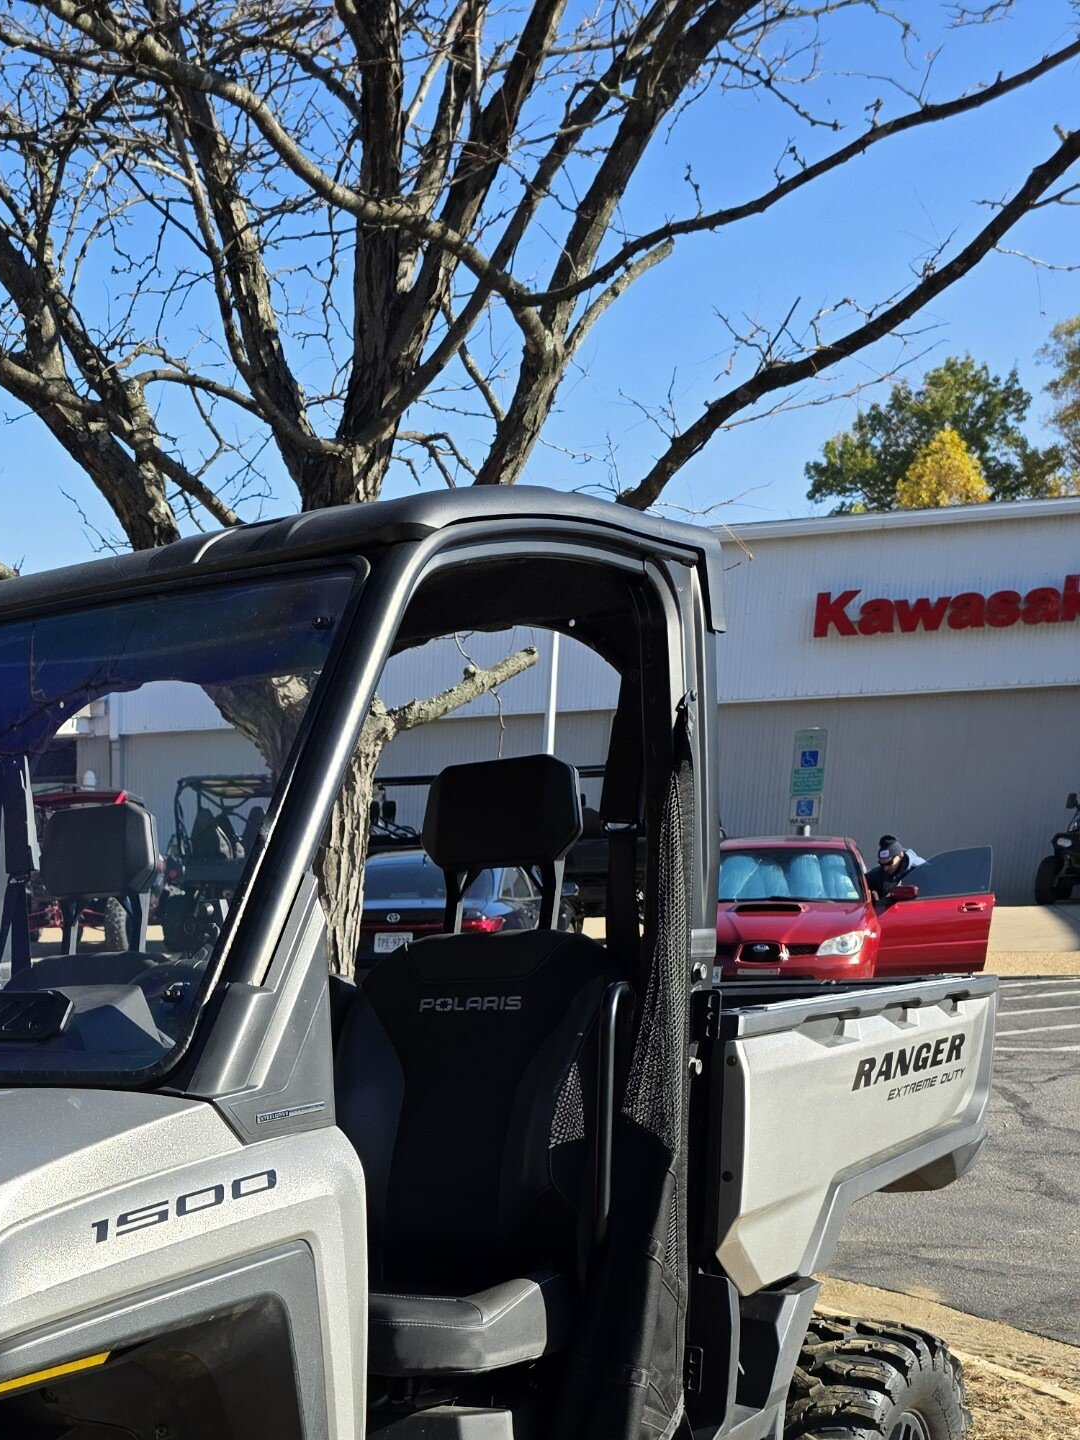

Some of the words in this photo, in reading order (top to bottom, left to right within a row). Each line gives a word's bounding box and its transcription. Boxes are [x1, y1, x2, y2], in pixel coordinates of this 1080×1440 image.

[419, 996, 522, 1013] POLARIS
[851, 1033, 966, 1091] RANGER
[887, 1075, 938, 1101] EXTREME
[940, 1067, 967, 1085] DUTY
[91, 1168, 277, 1243] 1500
